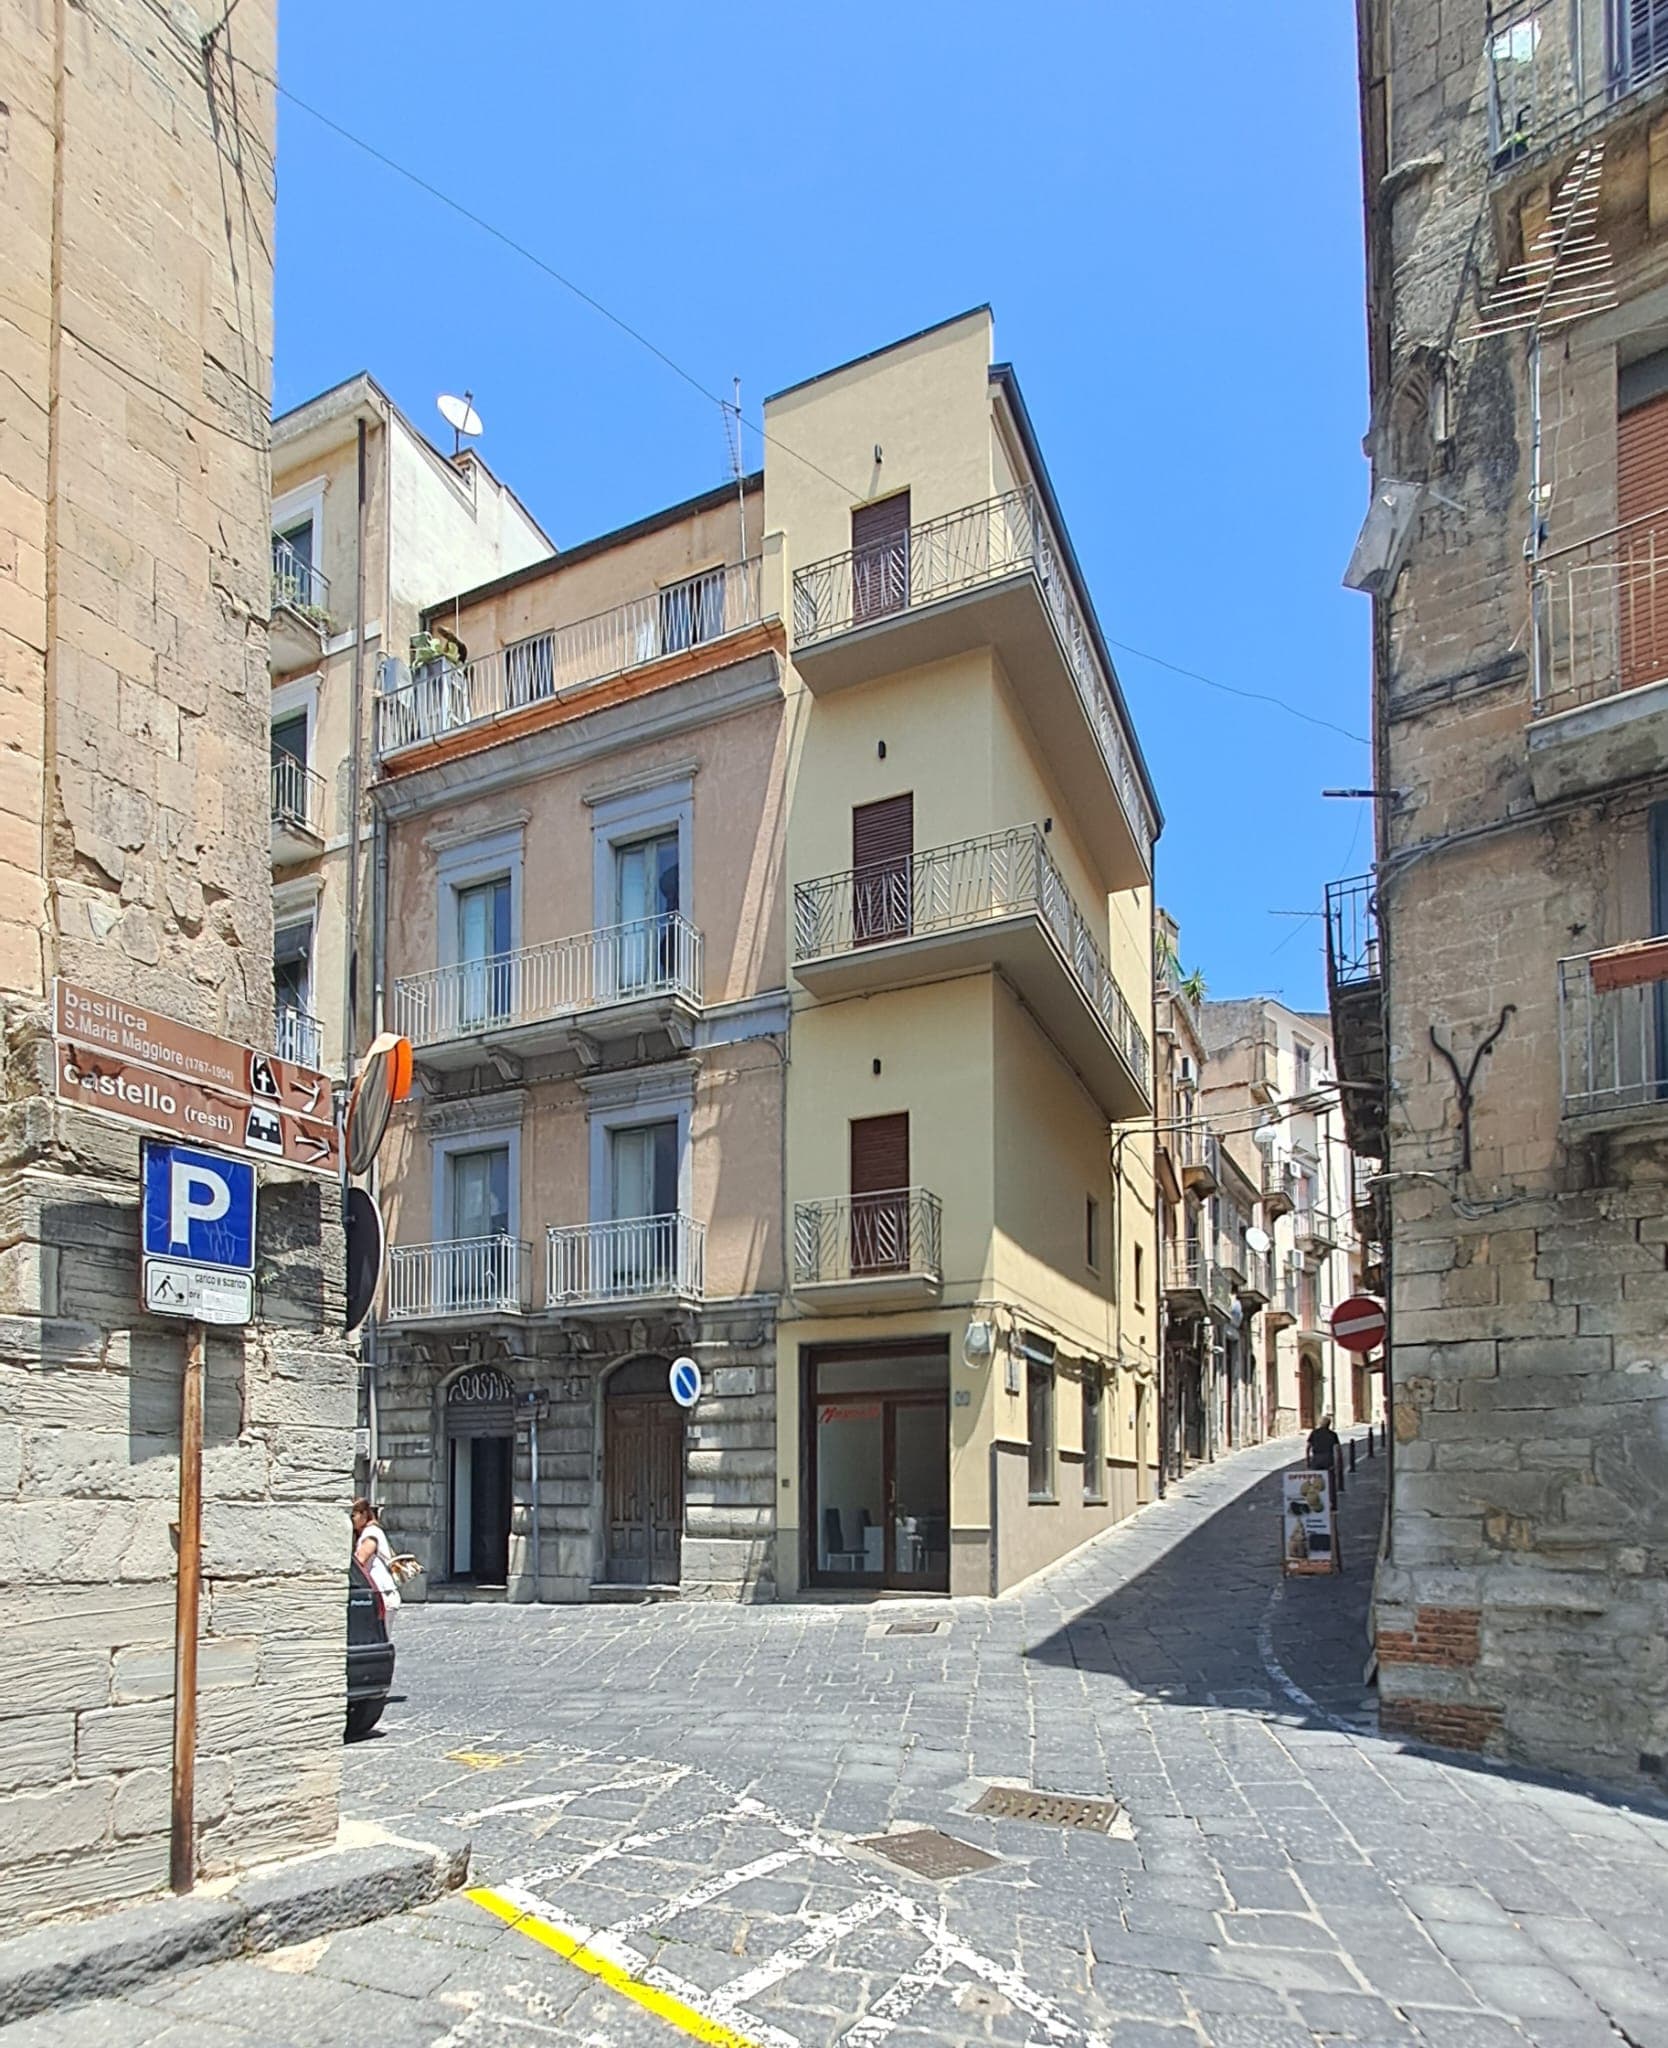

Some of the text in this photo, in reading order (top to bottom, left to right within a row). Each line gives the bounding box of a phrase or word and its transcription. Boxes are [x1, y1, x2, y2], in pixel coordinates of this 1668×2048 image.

[64, 1010, 118, 1043] S.Maria
[122, 1029, 183, 1065] Maggiore
[65, 988, 147, 1032] basilica
[63, 1063, 234, 1134] castello (resti)
[171, 1161, 231, 1245] P
[223, 1278, 248, 1290] scarico
